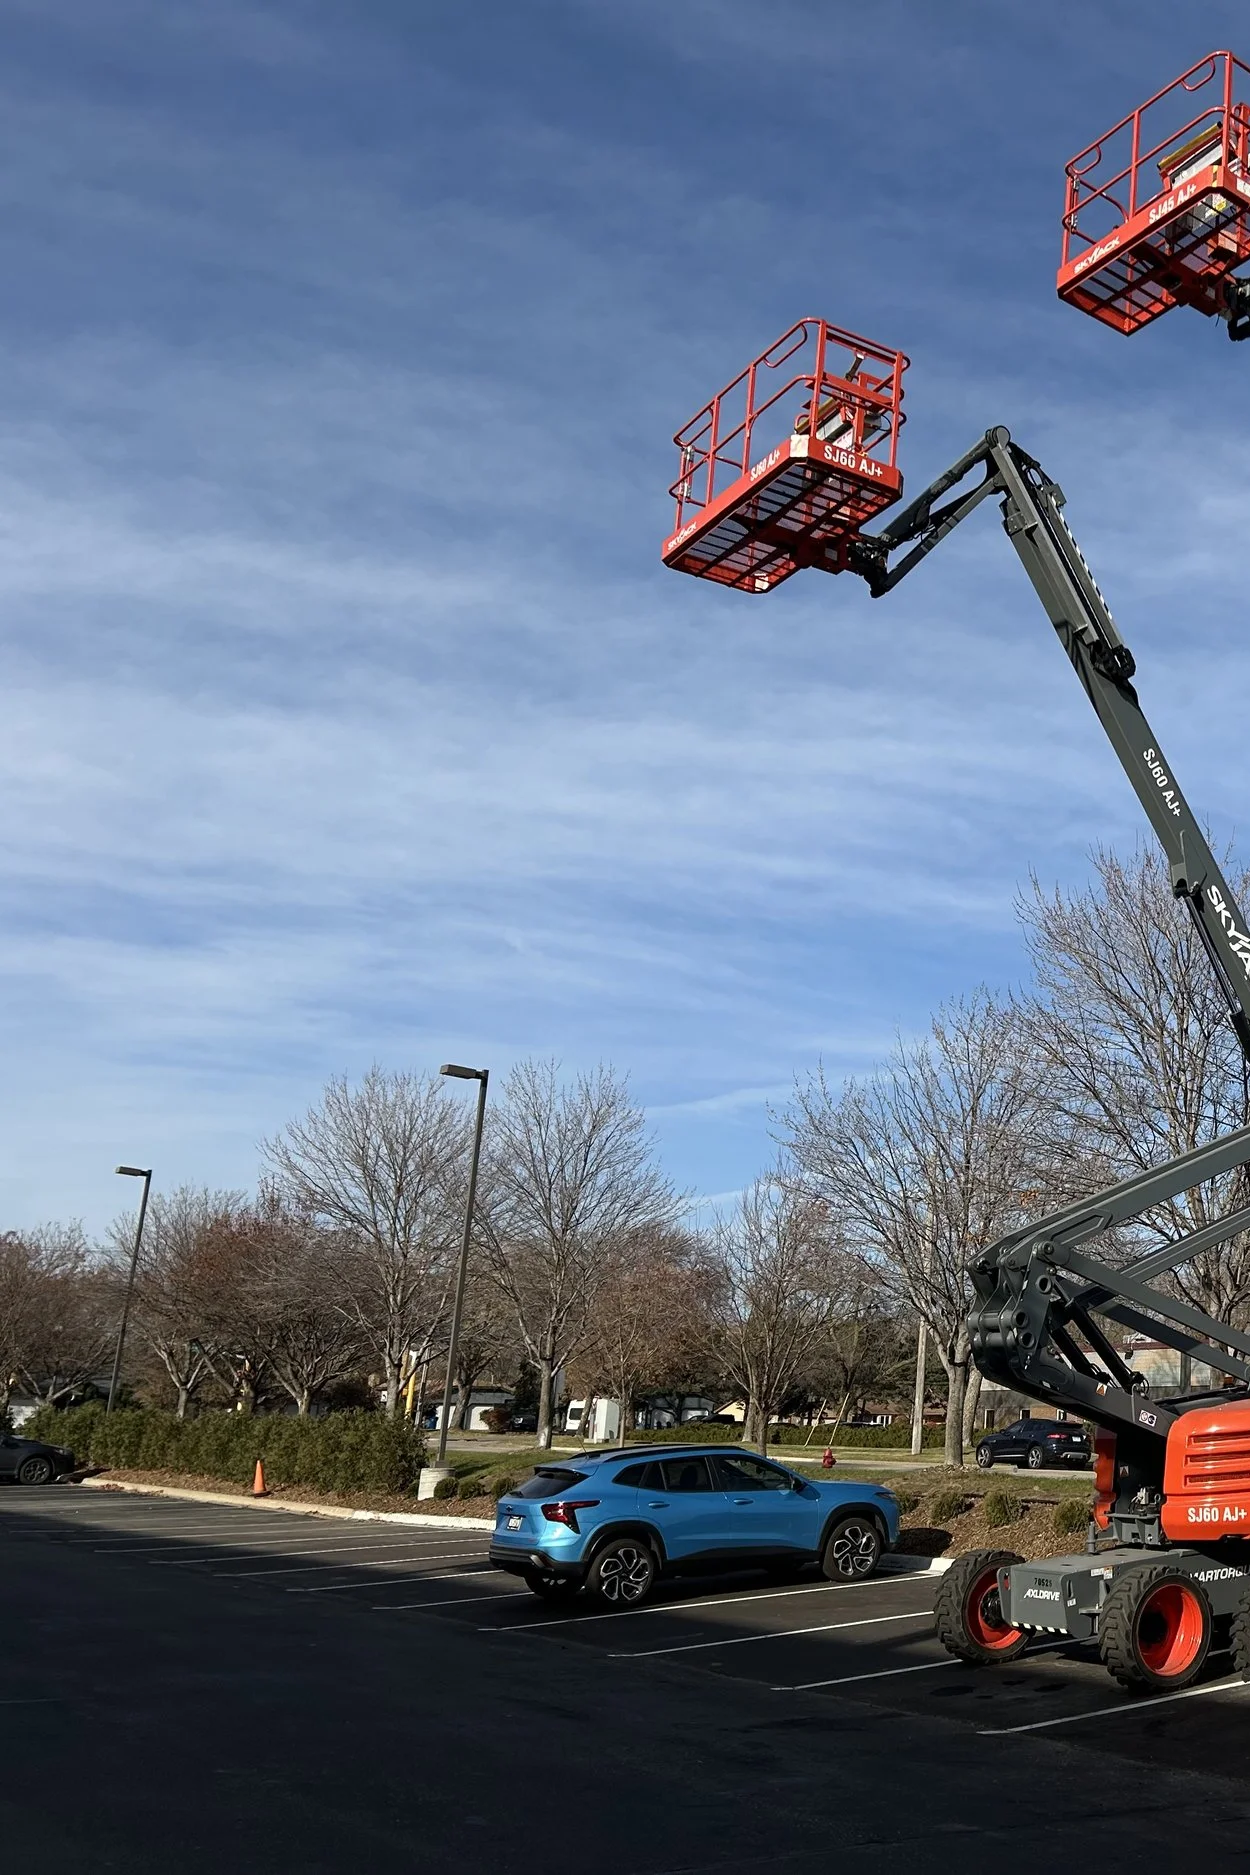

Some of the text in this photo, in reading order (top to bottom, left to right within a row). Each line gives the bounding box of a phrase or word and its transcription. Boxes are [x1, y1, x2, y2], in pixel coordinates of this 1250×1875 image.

[1149, 183, 1197, 225] SJ45 AJ+
[1074, 236, 1120, 274] SKYJACK
[750, 449, 781, 481] SJ60 AJ+
[824, 445, 883, 478] SJ60 AJ+
[667, 522, 697, 551] SKYJACK
[1143, 748, 1182, 817] SJ60 AJ+
[1187, 1506, 1248, 1523] SJ60 AJ+
[1023, 1588, 1061, 1601] AXLDRIVE
